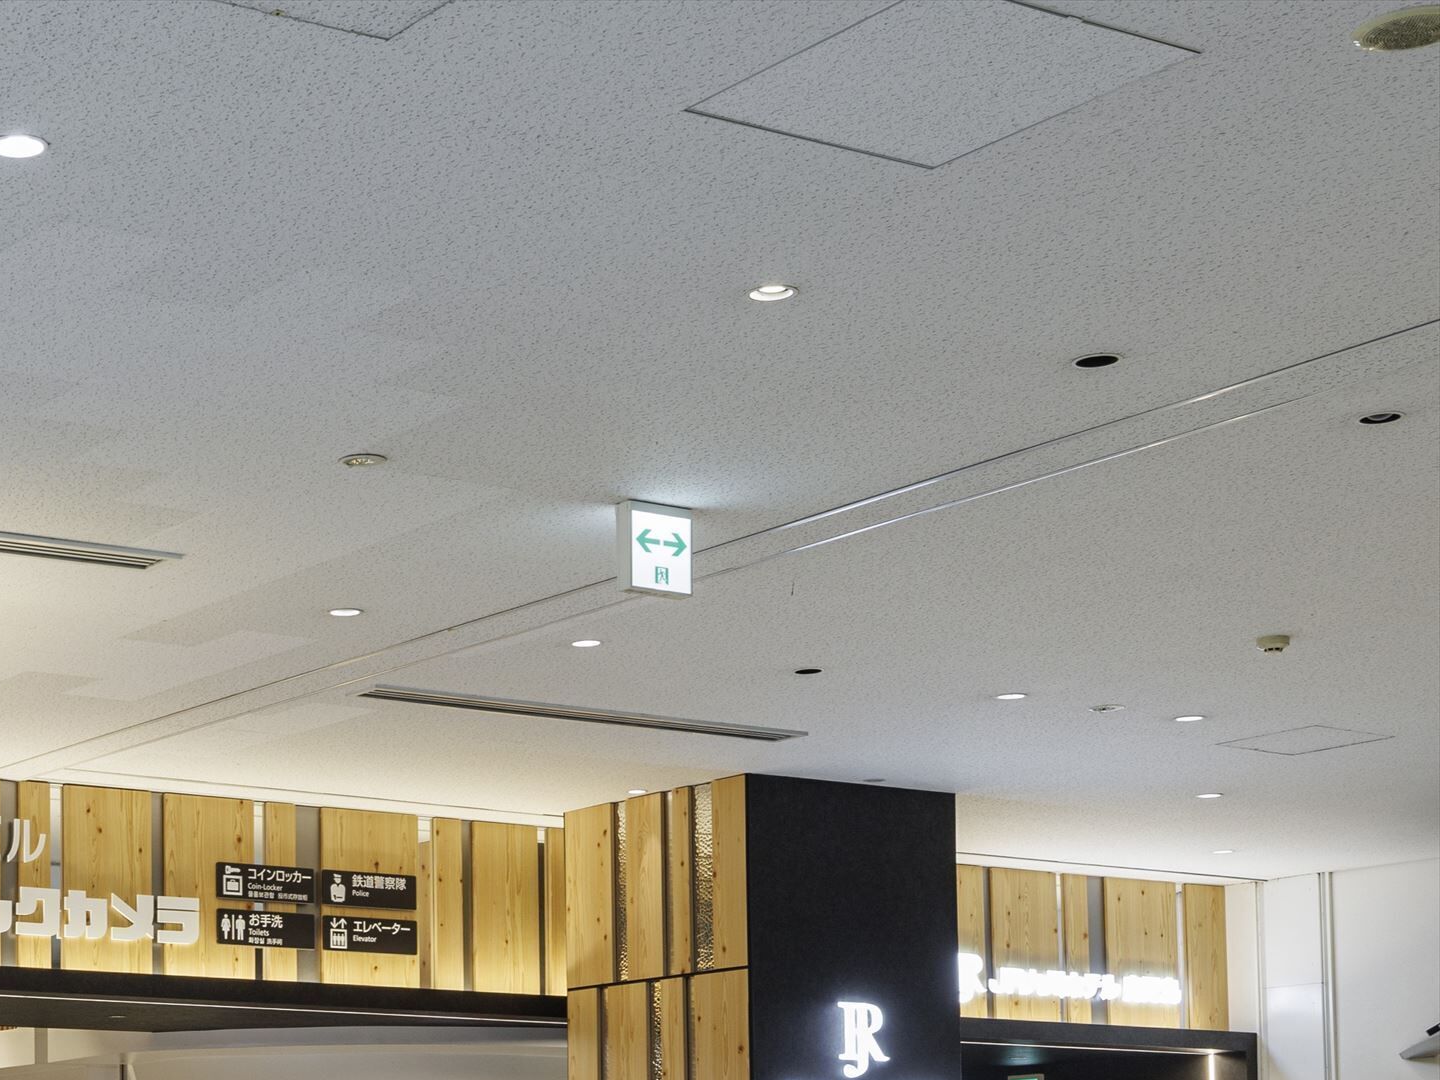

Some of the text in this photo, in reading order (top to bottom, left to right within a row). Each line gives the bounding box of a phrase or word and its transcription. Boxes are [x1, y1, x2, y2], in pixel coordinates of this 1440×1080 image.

[247, 868, 312, 884] コインロッカー
[247, 882, 283, 892] Coin-Locker
[352, 874, 407, 891] 鉄道警察隊
[352, 889, 370, 898] Police
[248, 913, 284, 929] お手洗
[248, 928, 270, 937] Toilets
[352, 920, 411, 935] エレベーター
[352, 935, 377, 943] Elevator
